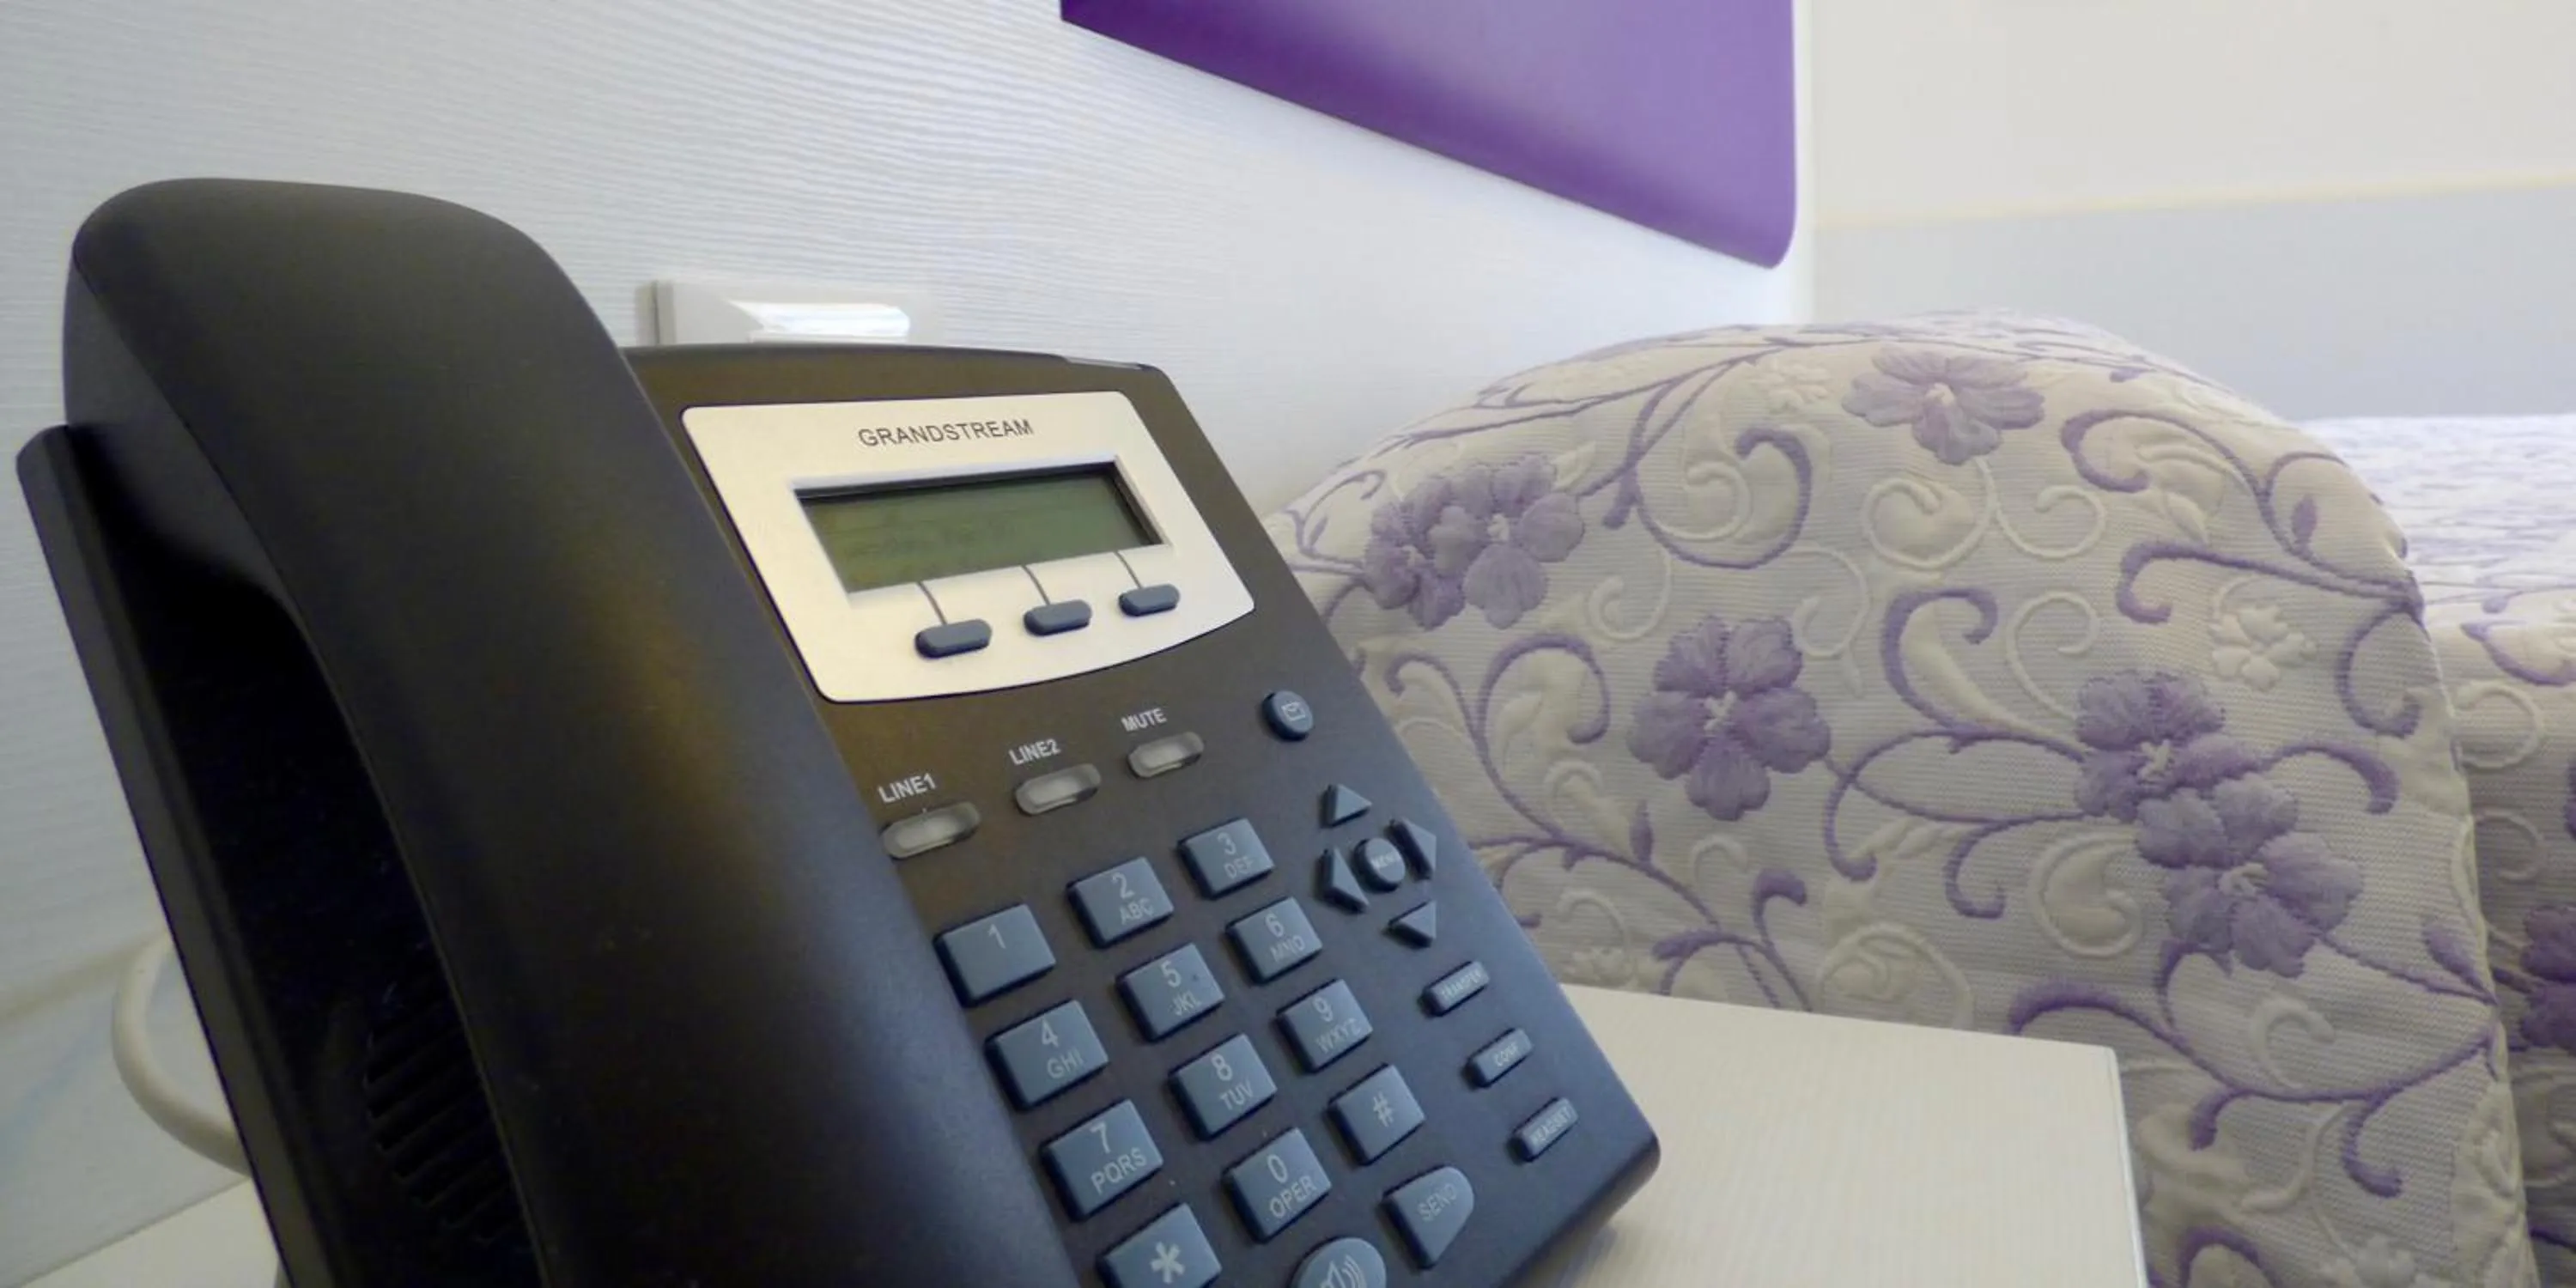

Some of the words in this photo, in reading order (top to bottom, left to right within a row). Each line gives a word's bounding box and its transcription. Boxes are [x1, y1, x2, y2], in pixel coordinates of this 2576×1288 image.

[859, 419, 1034, 447] GRANDSTREAM
[1121, 708, 1168, 732] MUTE
[1008, 738, 1061, 766] LINE2
[878, 774, 938, 804] LINE1
[1217, 832, 1236, 855] 3
[1223, 855, 1254, 880] DEF
[1111, 872, 1135, 898] 2
[1119, 897, 1156, 926] ABC
[1265, 913, 1284, 938] 6
[987, 924, 1007, 949] 1
[1270, 935, 1306, 963] MNO
[1159, 960, 1182, 987] 5
[1170, 990, 1203, 1017] JKL
[1312, 996, 1334, 1022] 9
[1039, 1019, 1059, 1048] 4
[1315, 1018, 1362, 1054] WXYZ
[1047, 1048, 1085, 1079] GHI
[1211, 1053, 1233, 1081] 8
[1219, 1084, 1255, 1111] TUV
[1089, 1121, 1114, 1154] 7
[1090, 1146, 1148, 1194] PQRS
[1268, 1175, 1318, 1219] OPER
[1418, 1182, 1457, 1221] SEND
